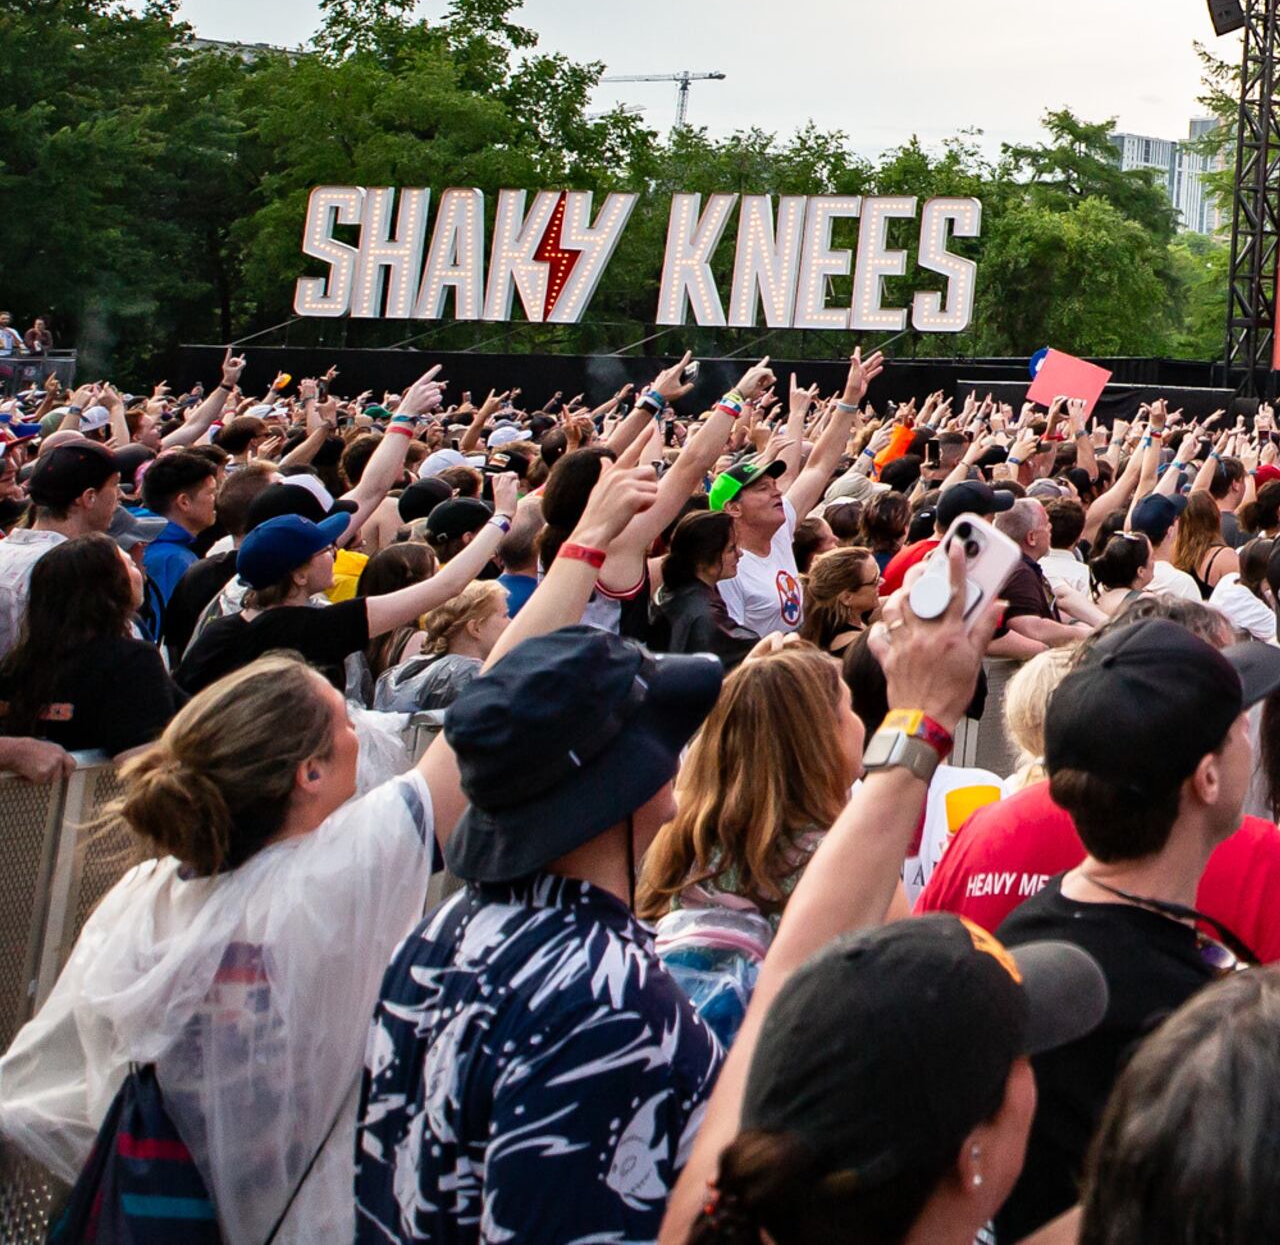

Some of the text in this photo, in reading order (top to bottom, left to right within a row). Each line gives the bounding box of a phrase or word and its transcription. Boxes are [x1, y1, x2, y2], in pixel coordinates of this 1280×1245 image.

[294, 186, 982, 332] SHAKY KNEES
[966, 871, 1017, 898] HEAVY
